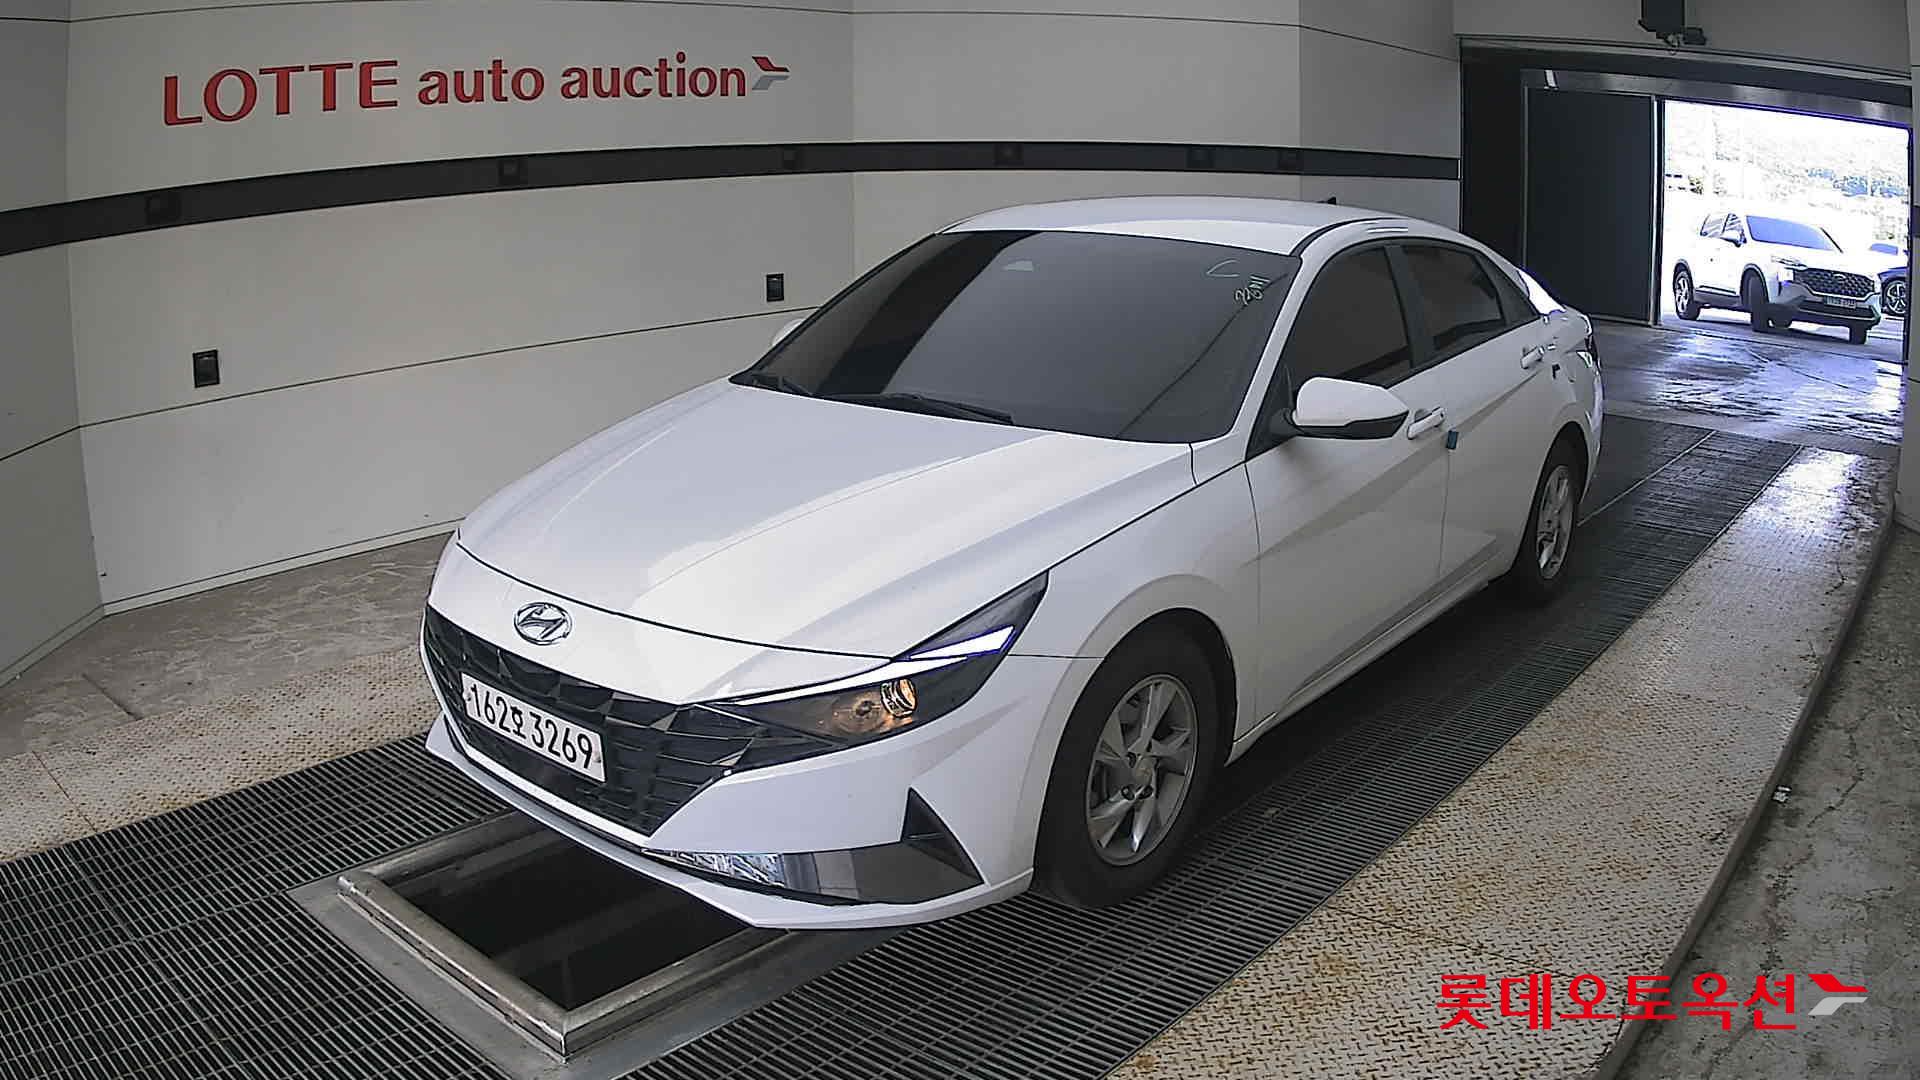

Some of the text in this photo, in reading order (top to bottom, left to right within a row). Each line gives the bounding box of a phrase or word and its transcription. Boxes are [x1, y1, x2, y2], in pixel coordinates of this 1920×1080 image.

[163, 51, 748, 126] LOTTE auto auction
[529, 712, 593, 769] 3269
